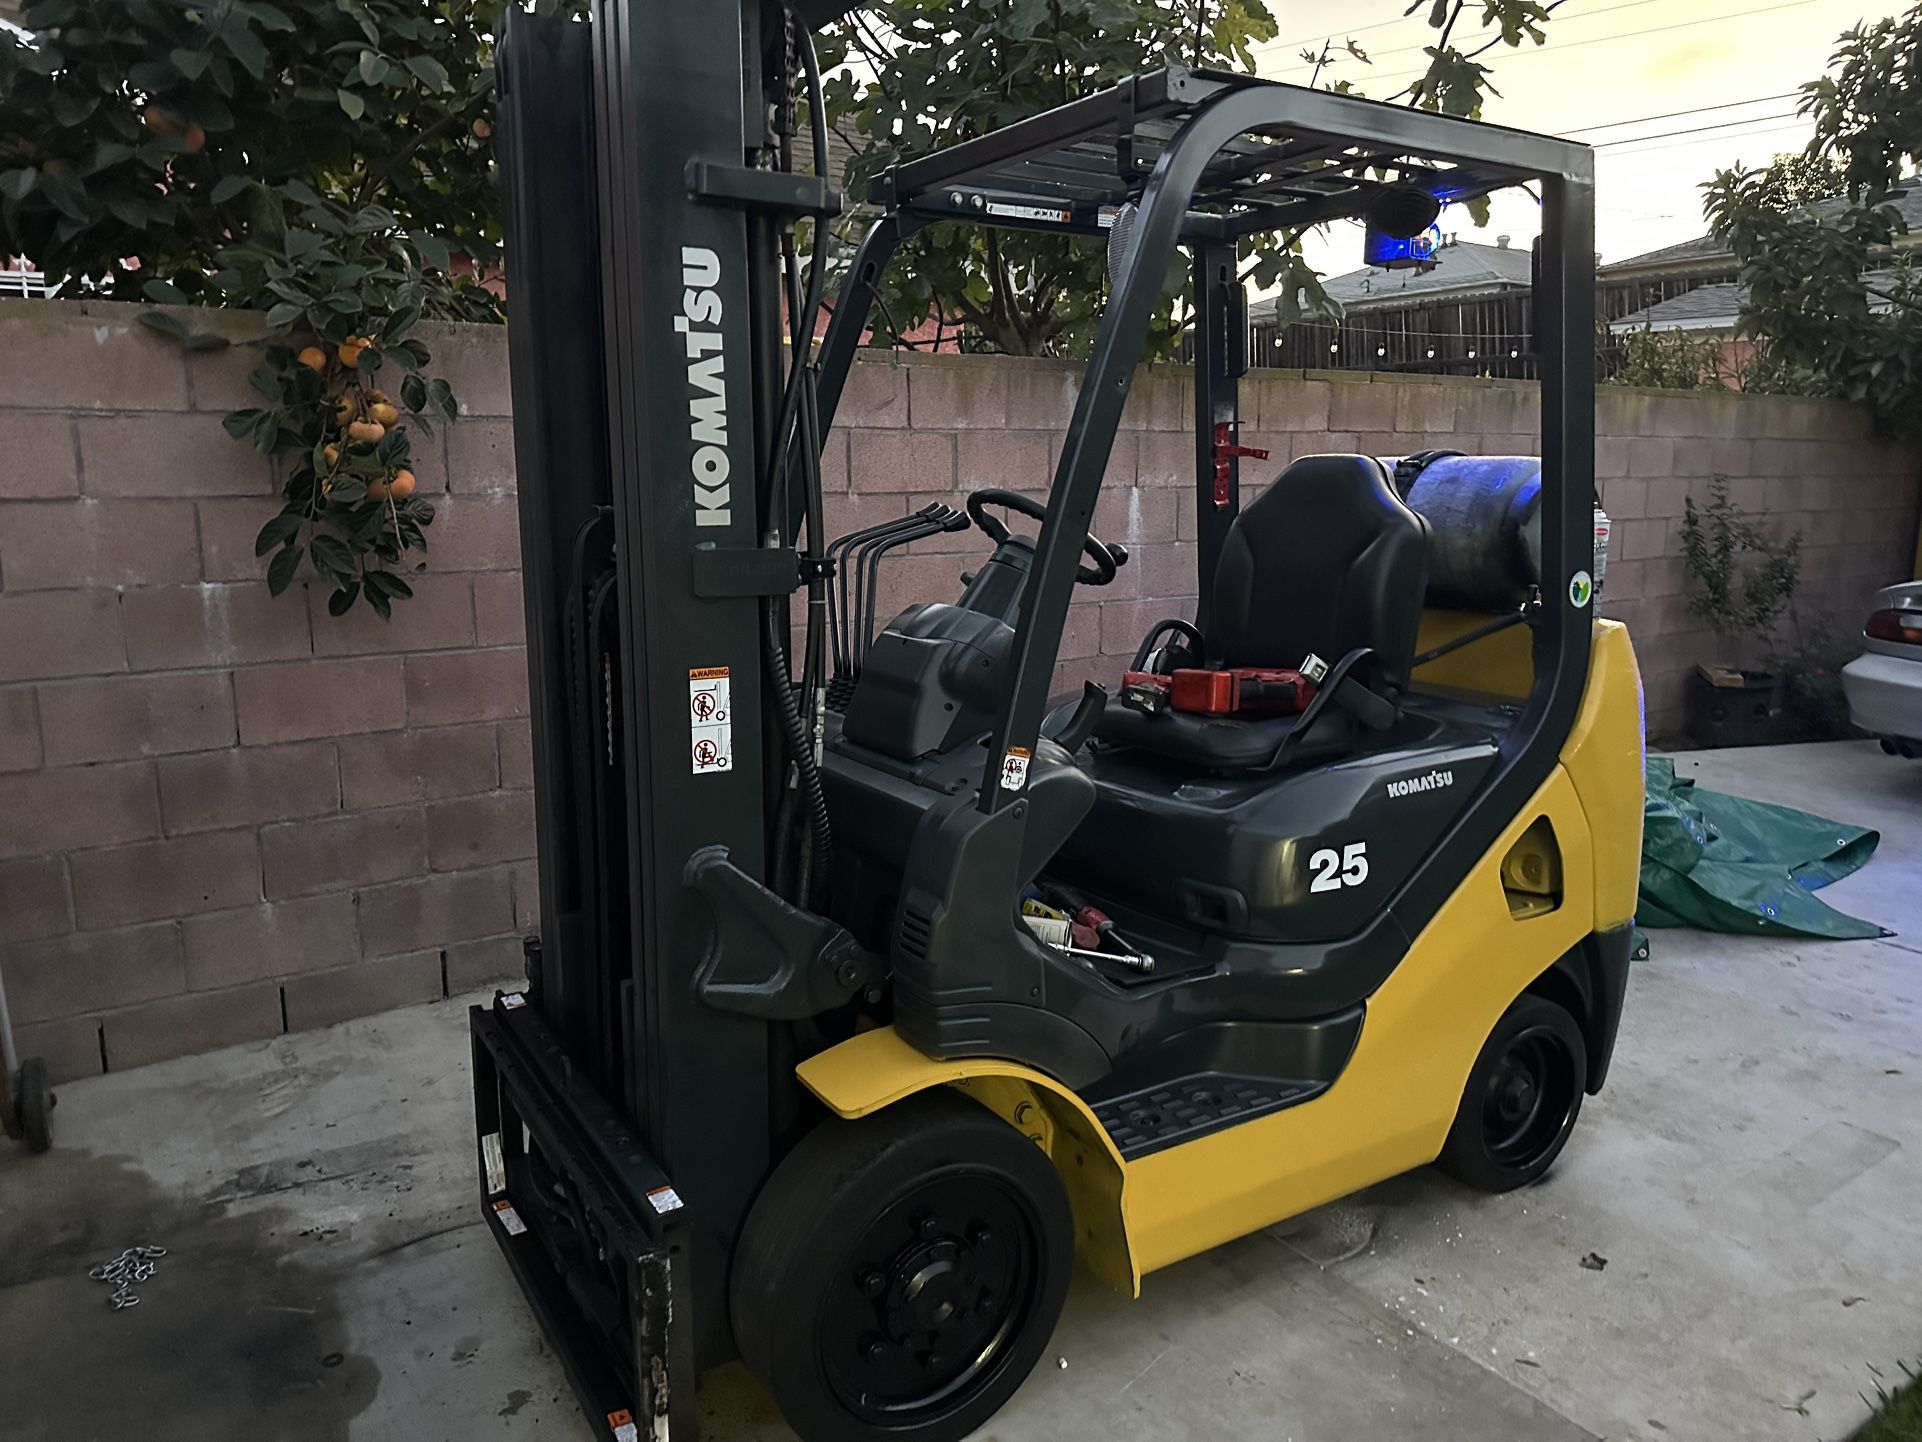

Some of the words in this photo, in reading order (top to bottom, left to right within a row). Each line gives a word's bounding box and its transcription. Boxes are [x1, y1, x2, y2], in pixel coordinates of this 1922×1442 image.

[673, 246, 732, 527] KOMATSU
[696, 668, 729, 677] WARNING
[1386, 770, 1454, 799] KOMATSU
[1309, 841, 1369, 894] 25
